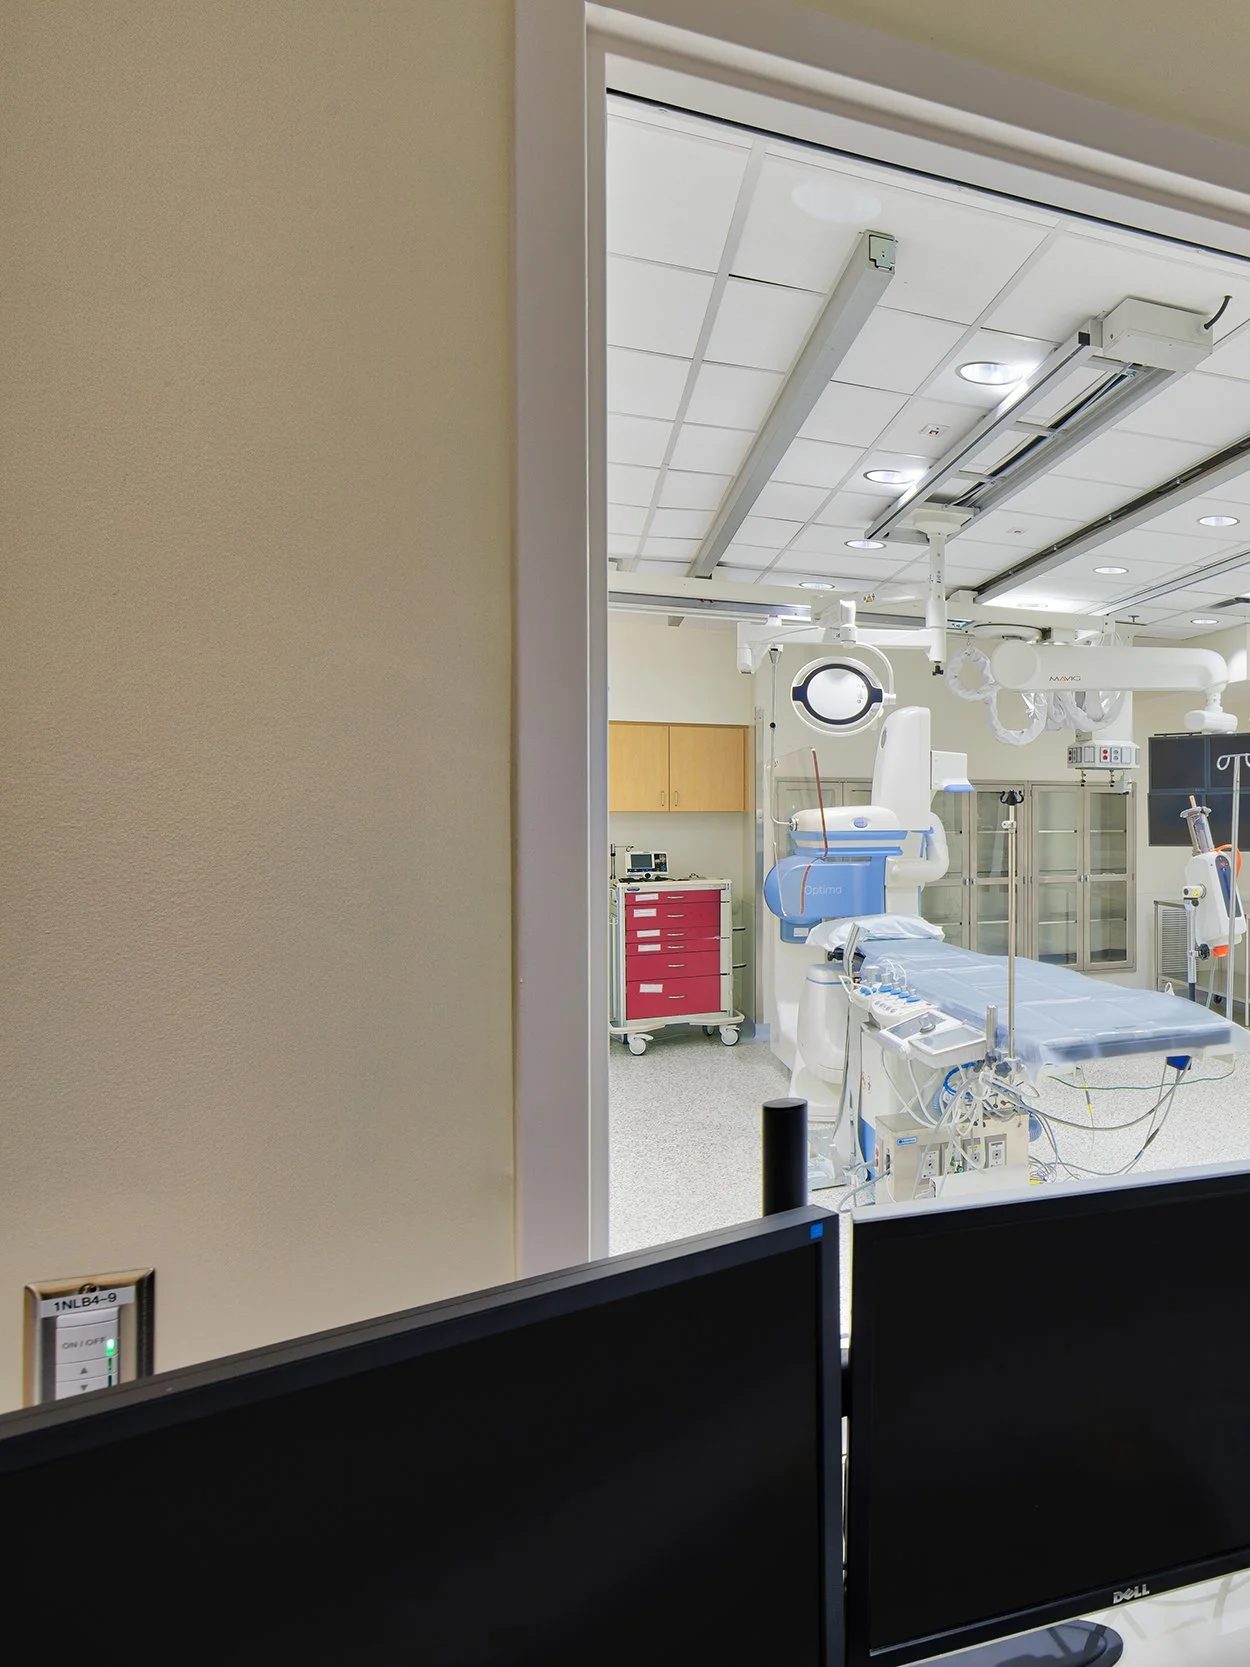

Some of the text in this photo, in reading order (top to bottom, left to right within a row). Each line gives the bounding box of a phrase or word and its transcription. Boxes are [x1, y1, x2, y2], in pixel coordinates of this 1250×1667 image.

[805, 885, 842, 896] Optima
[54, 1292, 117, 1311] 1NLB4-9
[1113, 1584, 1150, 1604] DELL
